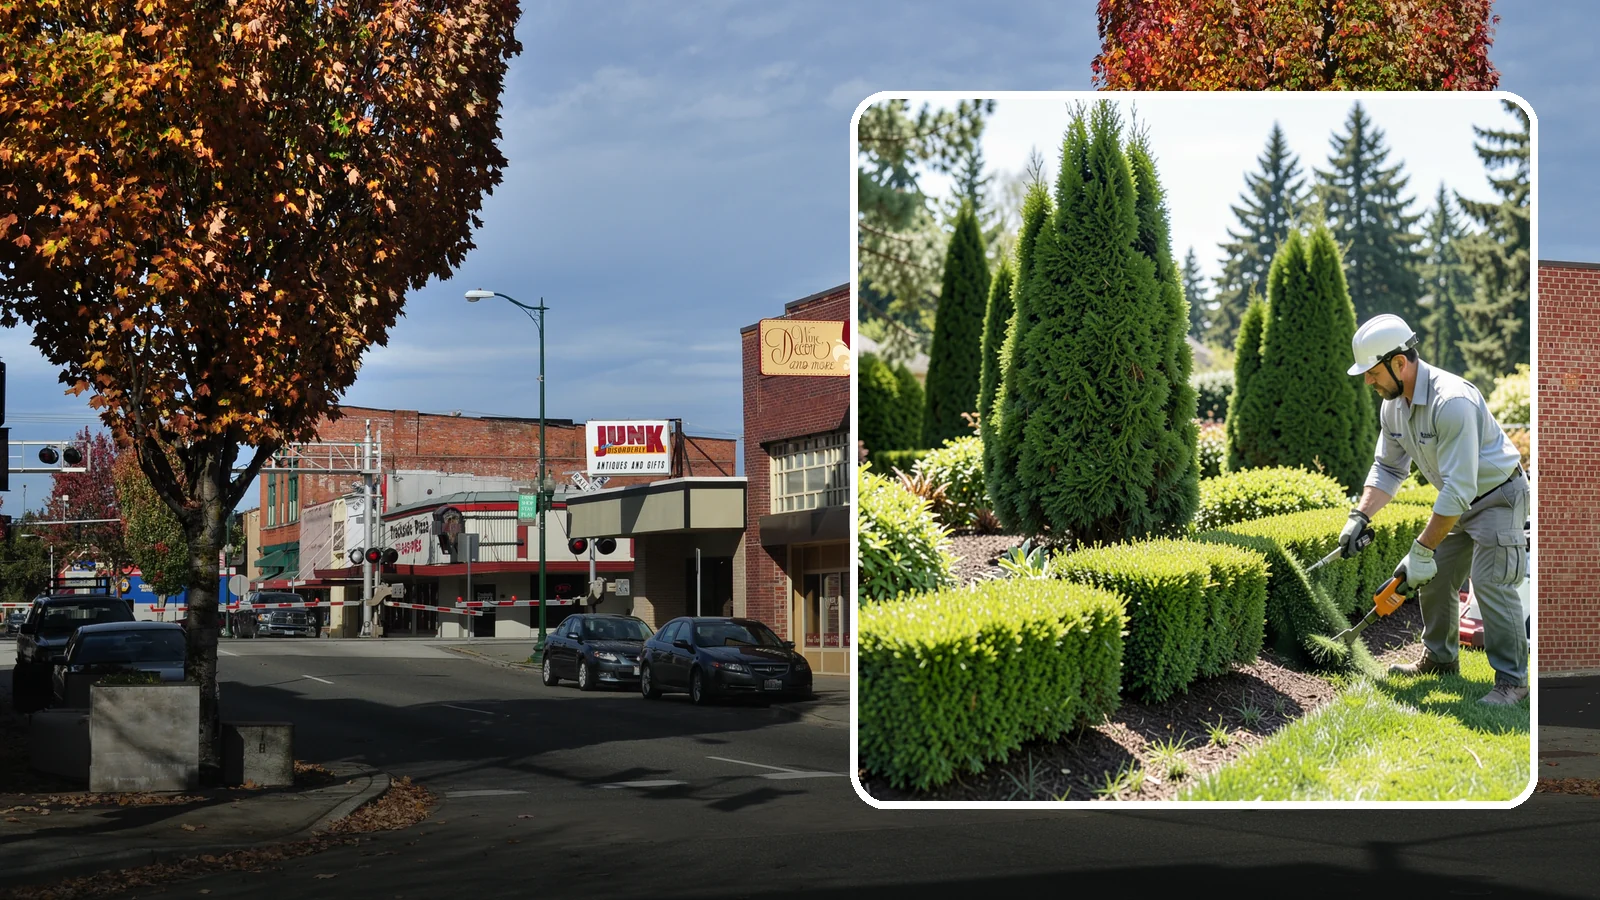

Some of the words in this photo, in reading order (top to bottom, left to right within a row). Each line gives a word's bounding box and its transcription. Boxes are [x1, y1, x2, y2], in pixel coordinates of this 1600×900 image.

[596, 425, 665, 457] JUNK
[607, 446, 646, 454] DISORDERLY
[597, 461, 628, 470] ANTIQUES
[631, 461, 644, 470] AND
[647, 460, 665, 469] GIFTS
[414, 519, 429, 535] Pizza
